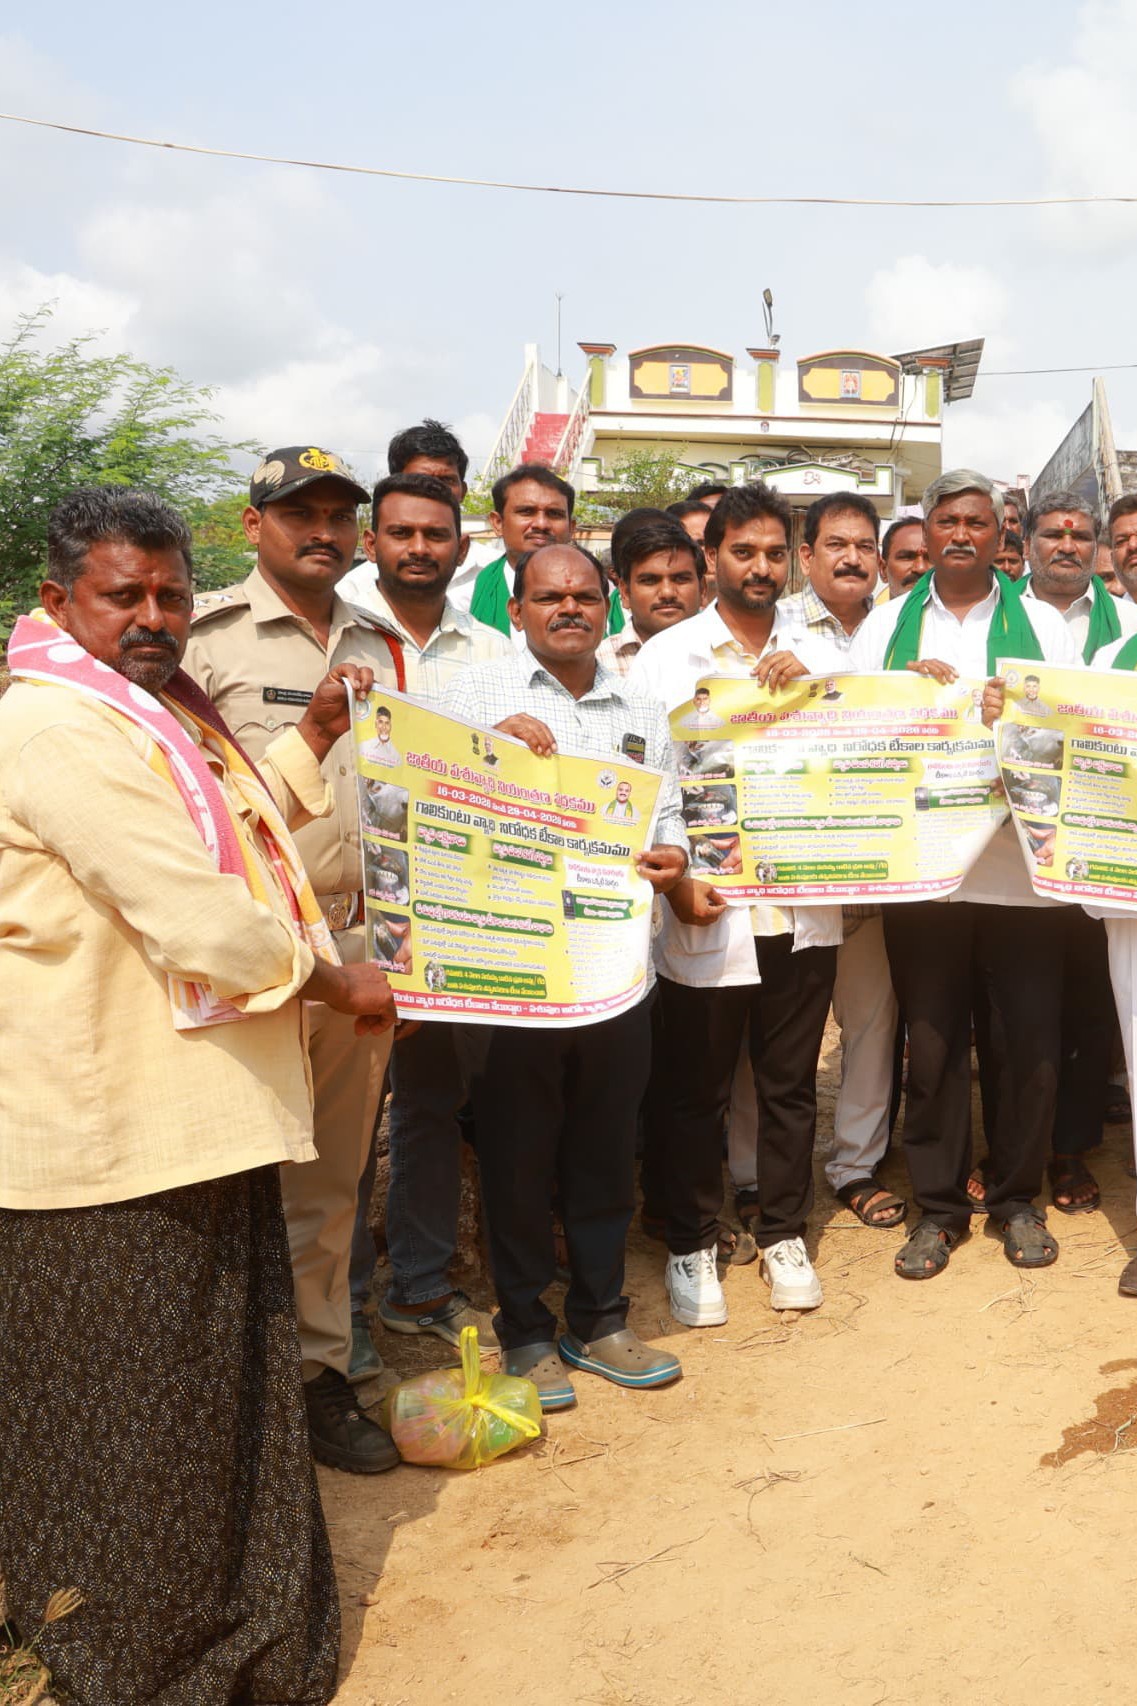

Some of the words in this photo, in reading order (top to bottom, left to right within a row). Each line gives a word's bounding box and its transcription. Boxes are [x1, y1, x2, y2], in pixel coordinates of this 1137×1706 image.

[730, 711, 777, 724] జాతీయ
[1057, 704, 1104, 719] జాతీయ
[889, 738, 924, 751] టీకాల
[1071, 739, 1127, 755] గాలికుంటు
[406, 752, 447, 776] జాతీయ
[415, 800, 471, 825] గాలికుంటు
[473, 815, 496, 835] వ్యాధి
[499, 821, 537, 841] నిరోధక
[539, 826, 564, 847] టీకాల
